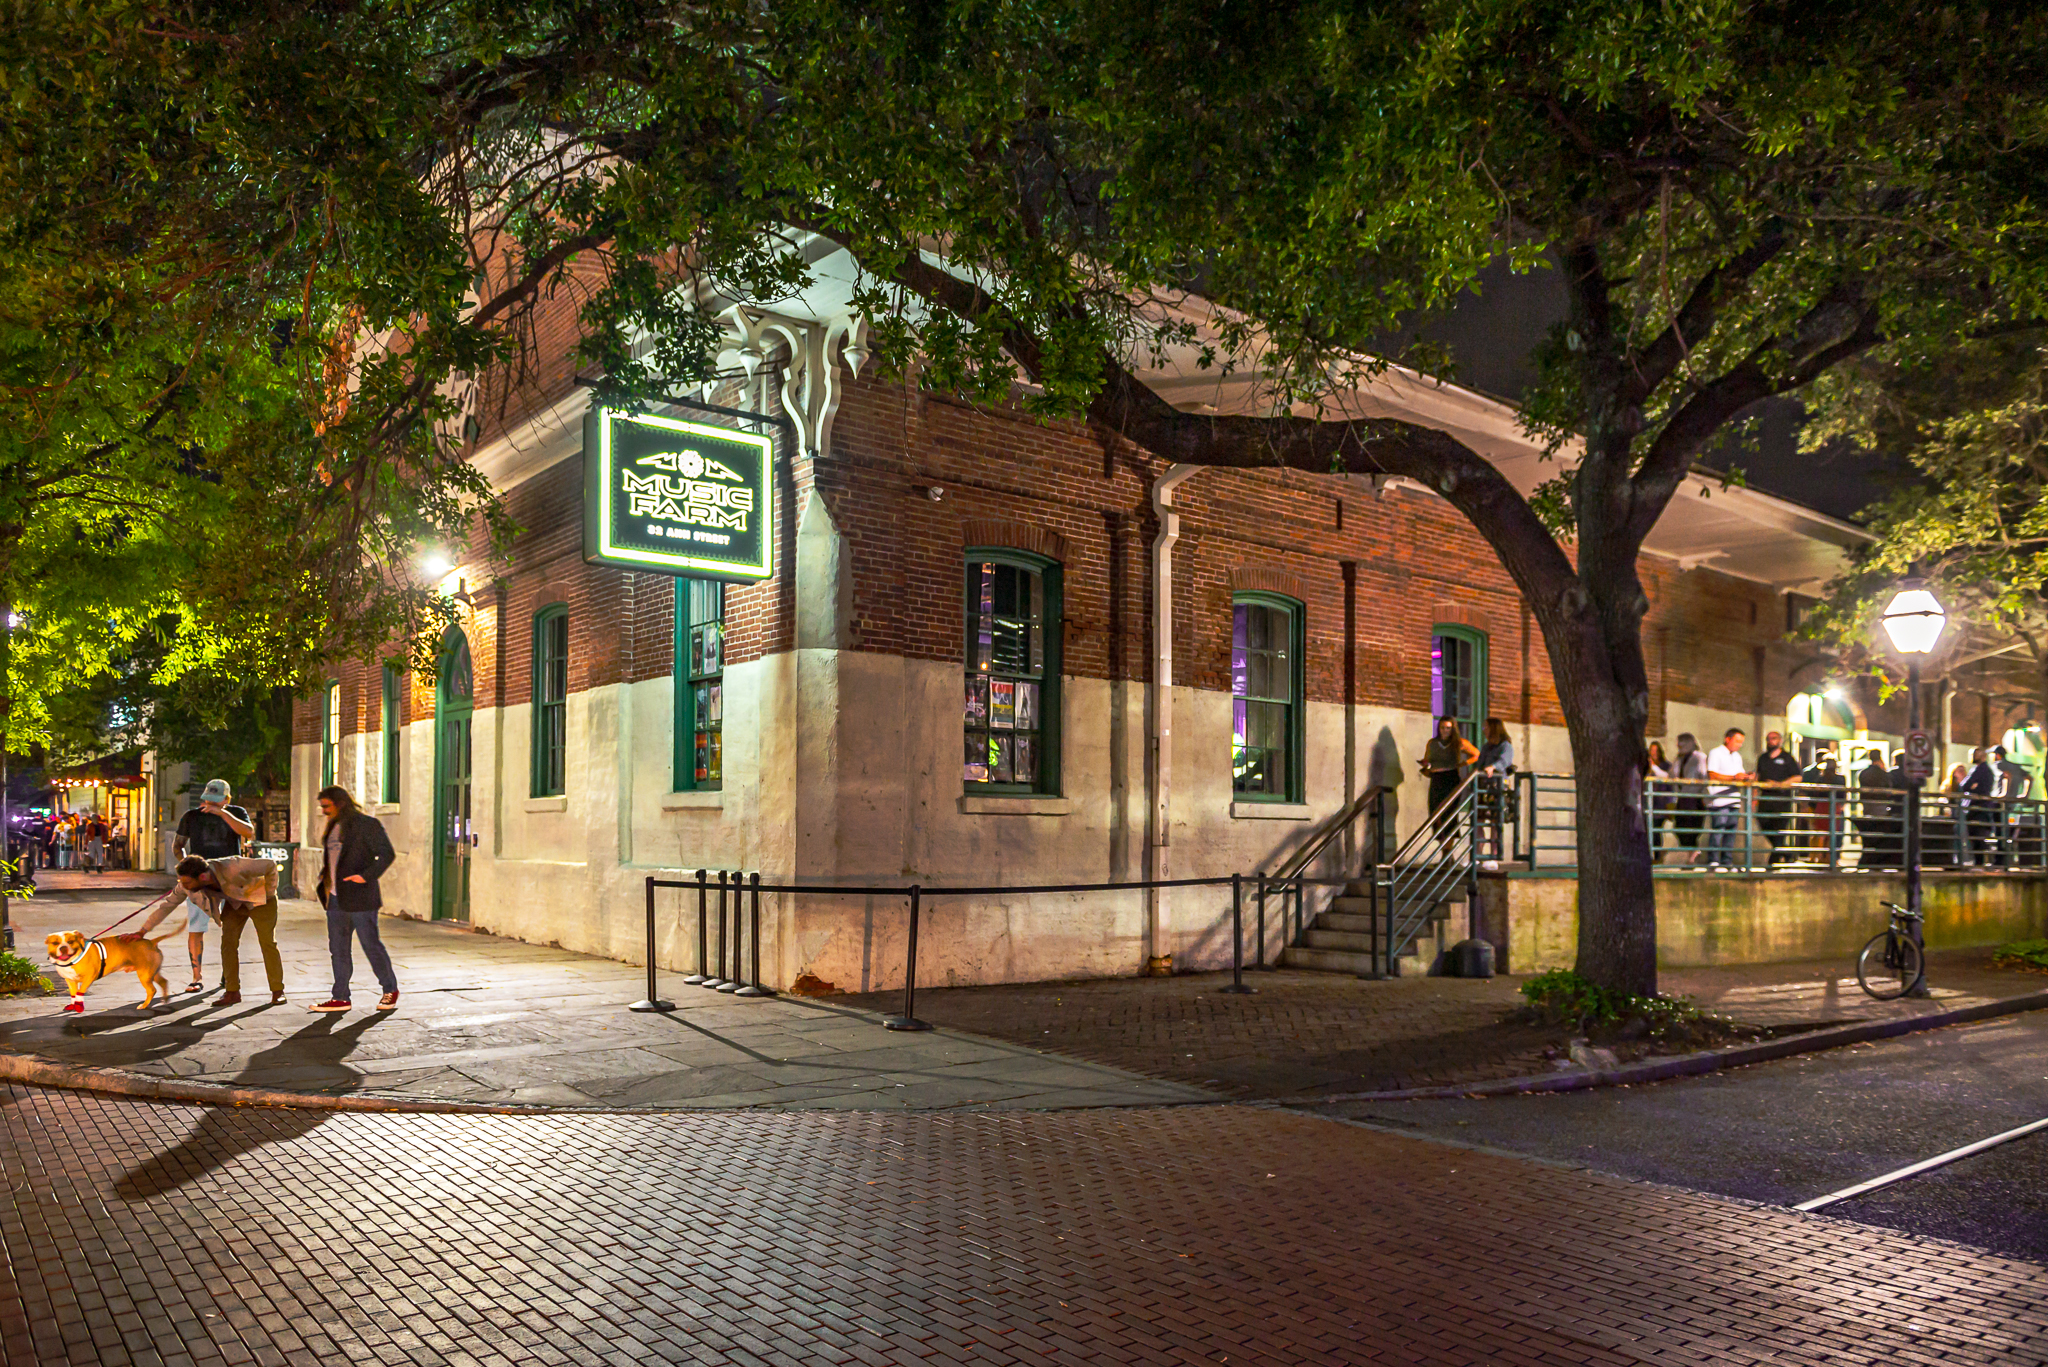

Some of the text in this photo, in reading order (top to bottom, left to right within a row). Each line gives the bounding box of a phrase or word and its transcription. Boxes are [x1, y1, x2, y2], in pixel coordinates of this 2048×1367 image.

[622, 468, 753, 512] MUSIC
[629, 493, 747, 532] FARM
[647, 524, 730, 545] 32 ANN STREET
